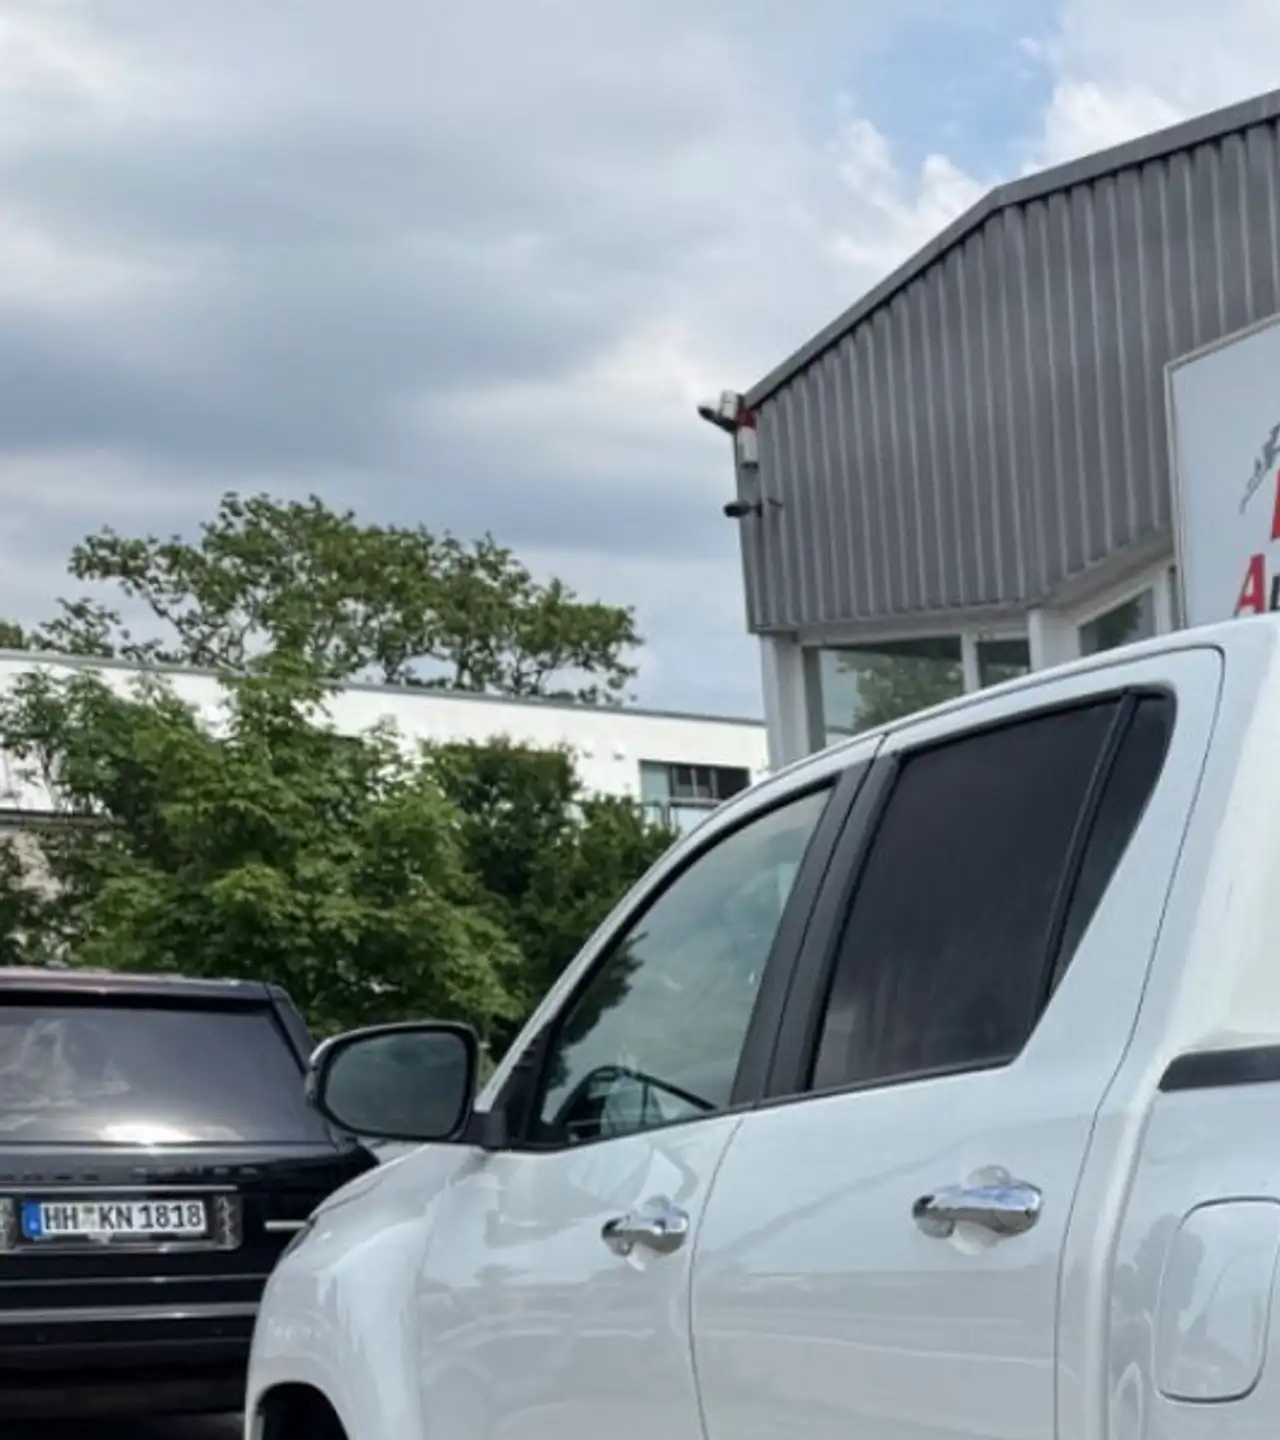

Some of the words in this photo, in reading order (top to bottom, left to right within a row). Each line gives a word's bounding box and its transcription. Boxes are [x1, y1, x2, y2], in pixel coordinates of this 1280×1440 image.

[44, 1206, 79, 1230] HH
[99, 1206, 134, 1230] KN
[139, 1204, 202, 1230] 1818
